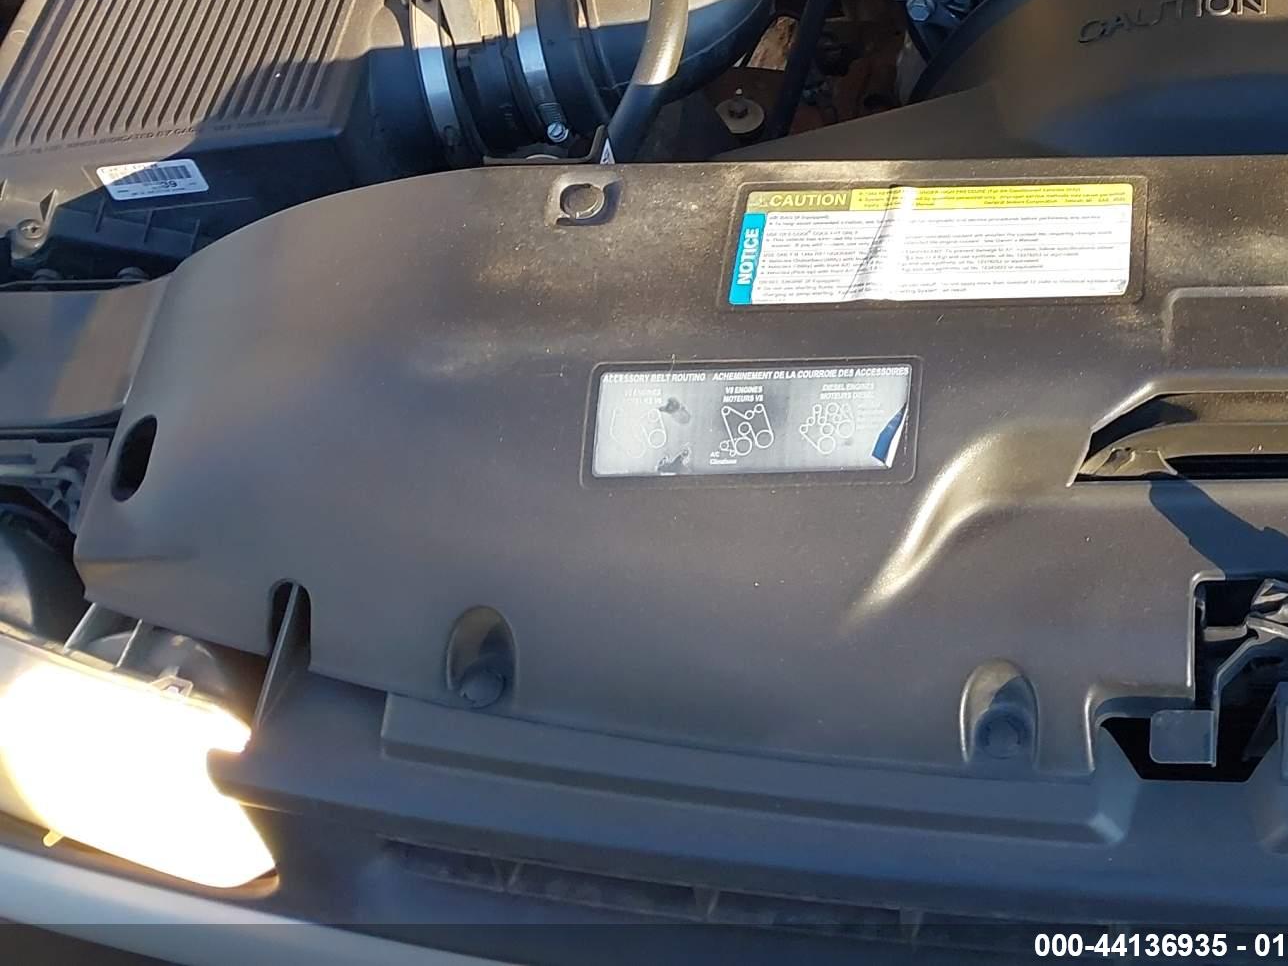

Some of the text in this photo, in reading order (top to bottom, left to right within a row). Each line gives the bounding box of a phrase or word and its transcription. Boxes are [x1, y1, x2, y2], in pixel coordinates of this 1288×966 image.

[769, 193, 847, 207] CAUTION
[737, 227, 759, 285] NOTICE
[602, 374, 650, 383] ACCESSORY
[650, 373, 671, 382] BELT
[672, 372, 706, 382] ROUTING
[712, 370, 774, 381] ACHEMINEMENT
[774, 370, 785, 379] DE
[785, 370, 796, 378] LA
[838, 368, 854, 377] DES
[854, 367, 910, 377] ACCESSOIRES
